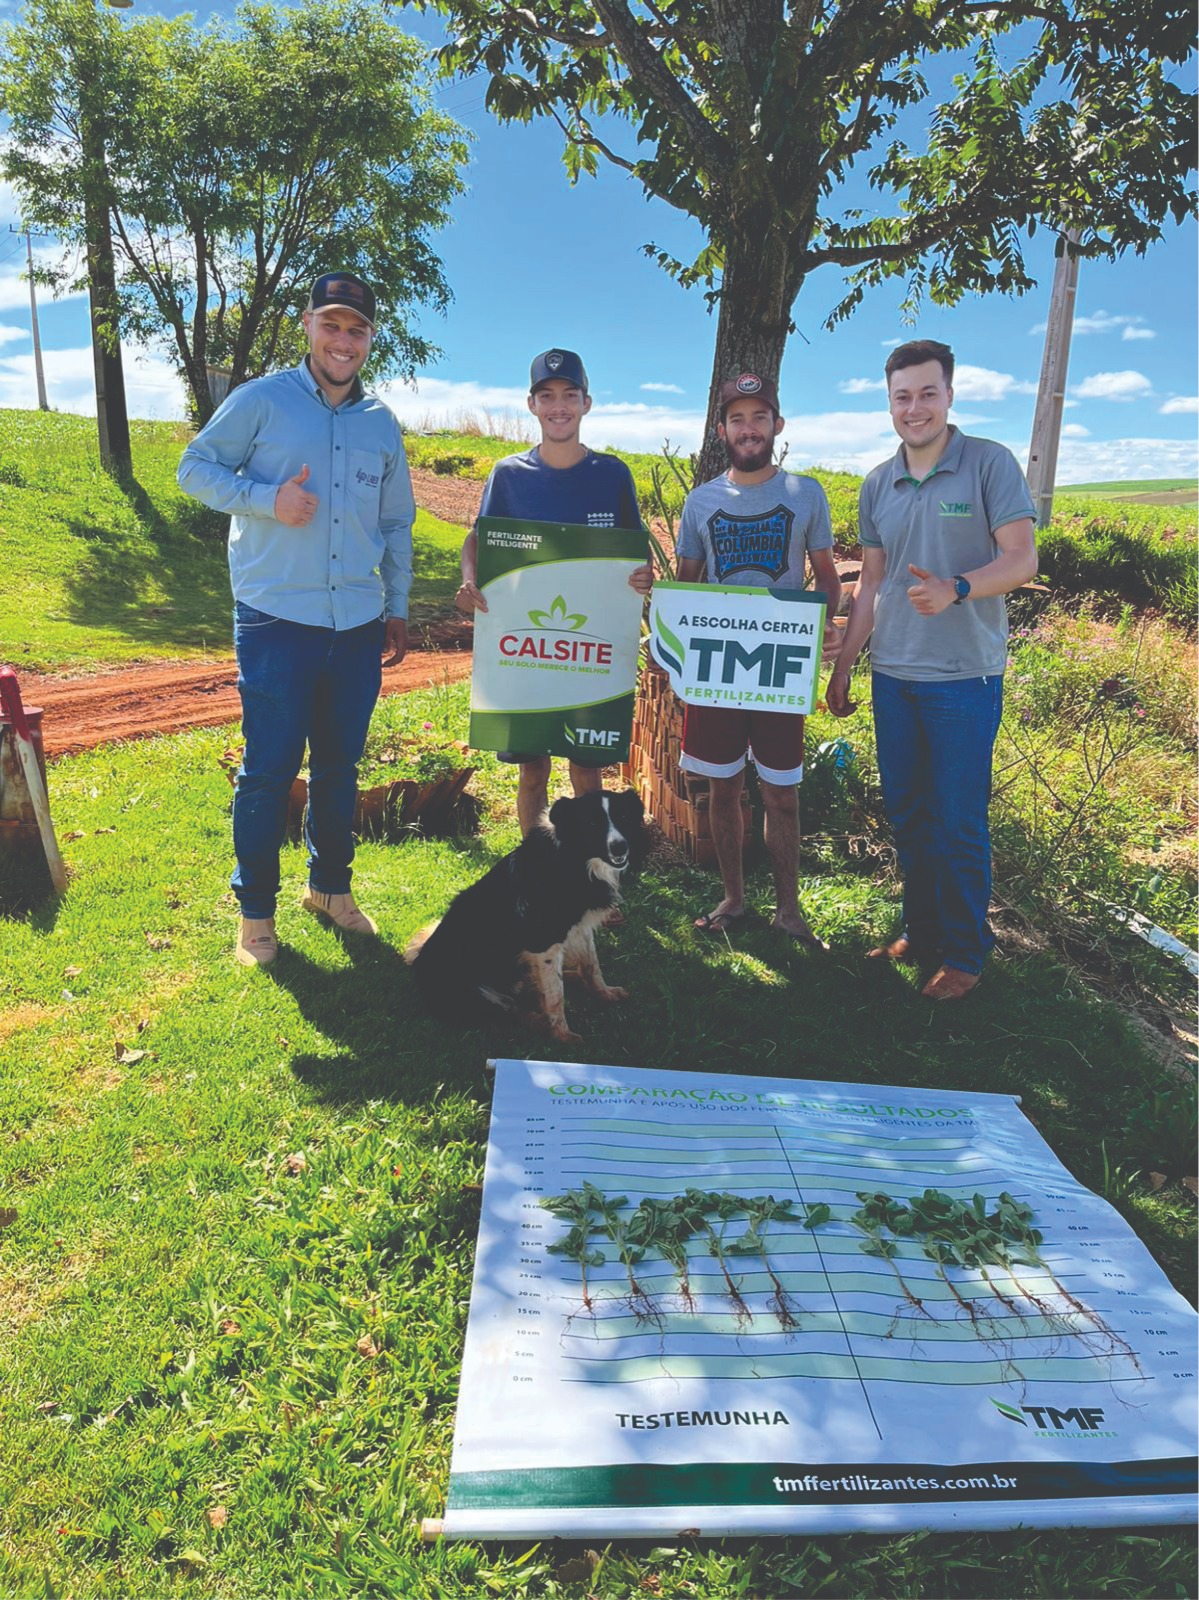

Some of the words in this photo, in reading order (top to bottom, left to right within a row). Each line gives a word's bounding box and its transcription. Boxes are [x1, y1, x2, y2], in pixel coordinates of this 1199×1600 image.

[947, 503, 972, 513] TMF
[487, 531, 543, 543] FERTILIZANTE
[487, 539, 538, 550] INTELIGENTE
[716, 535, 783, 555] COLUMBIA
[678, 615, 689, 626] A
[692, 616, 758, 631] ESCOLHA
[761, 621, 813, 635] CERTA!
[499, 635, 613, 664] CALSITE
[516, 661, 536, 669] SOLO
[538, 663, 569, 672] MERECE
[578, 666, 610, 674] MELHOR
[689, 637, 811, 688] TMF
[684, 687, 806, 706] FERTILIZANTES
[575, 728, 620, 746] TMF
[548, 1084, 748, 1104] COMPARAÇÃO
[551, 1098, 637, 1106] TESTEMUNHA
[720, 1104, 747, 1112] DOS
[615, 1410, 790, 1430] TESTEMUNHA
[1021, 1406, 1105, 1430] TMF
[772, 1474, 1018, 1492] tmffertilizantes.com.br
